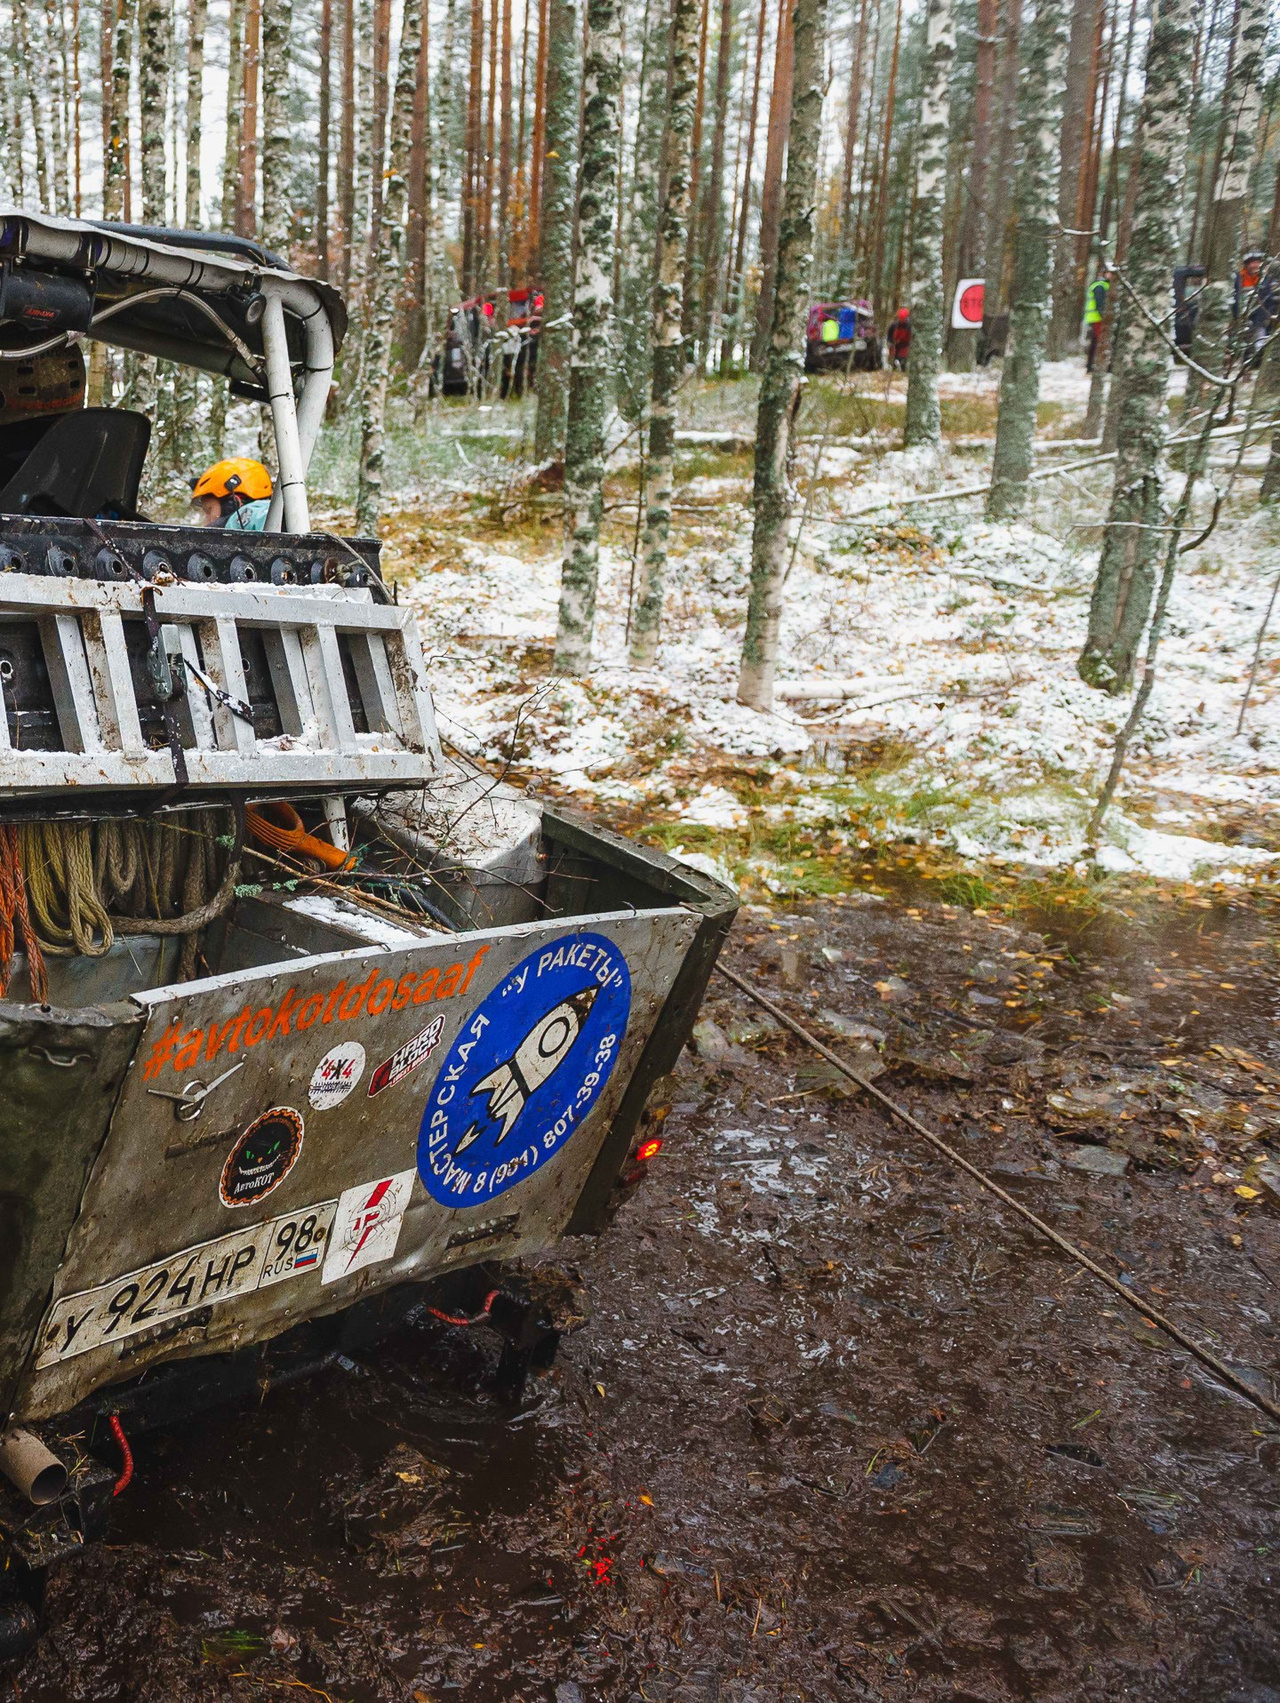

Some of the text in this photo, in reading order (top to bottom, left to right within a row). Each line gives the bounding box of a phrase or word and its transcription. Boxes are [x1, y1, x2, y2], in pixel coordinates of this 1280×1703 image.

[142, 944, 492, 1082] #avtokotdosaaf
[388, 1033, 437, 1081] BLOCK
[392, 1018, 442, 1068] HARD
[428, 1013, 491, 1195] МАСТЕРСКАЯ
[543, 1032, 617, 1149] 807-39-38
[275, 1215, 319, 1261] 98
[262, 1256, 295, 1280] RUS
